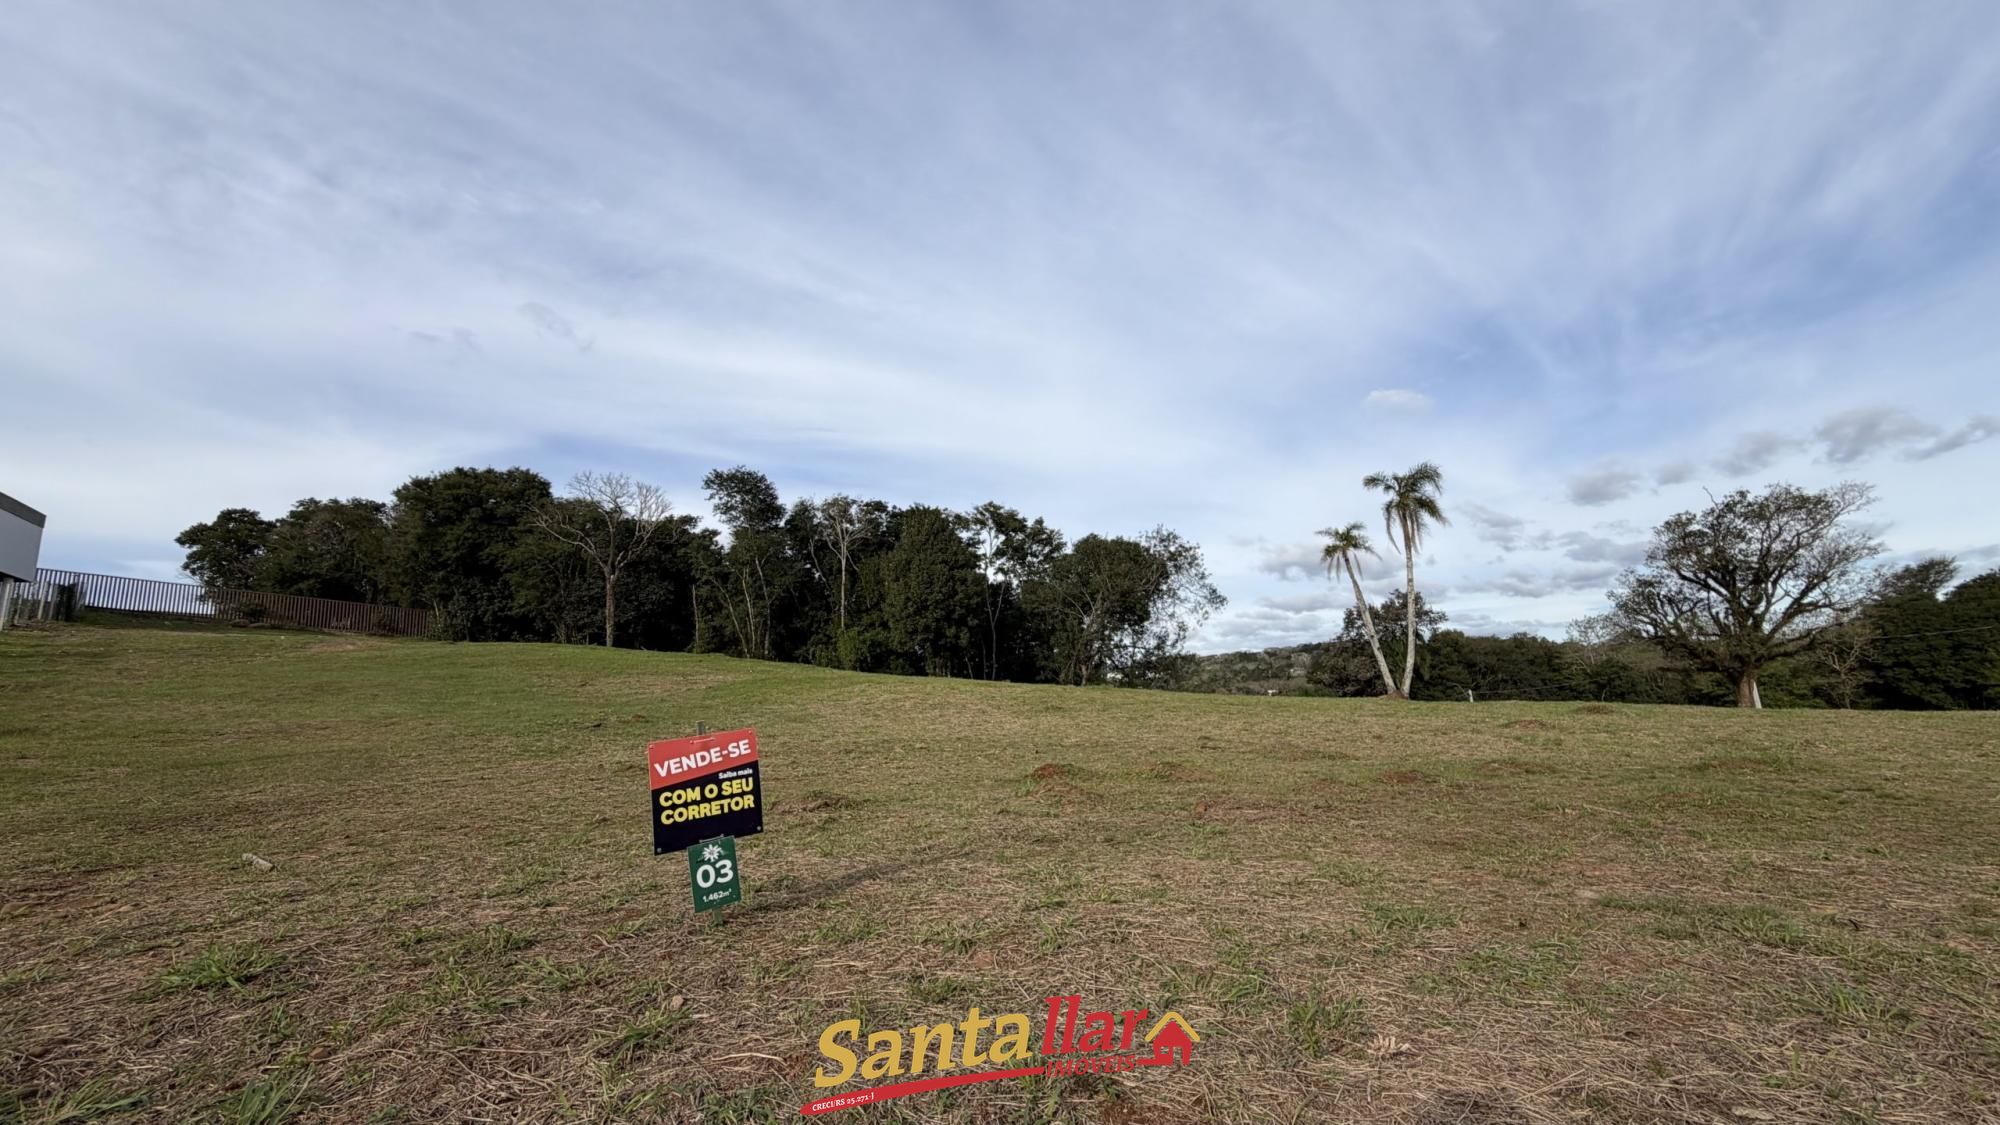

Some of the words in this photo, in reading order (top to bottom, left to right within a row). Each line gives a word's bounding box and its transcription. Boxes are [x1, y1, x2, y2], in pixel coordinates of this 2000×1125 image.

[654, 739, 751, 777] VENDE-SE
[718, 771, 737, 779] Saiba
[737, 768, 753, 776] mais
[659, 786, 701, 807] COM
[704, 783, 718, 799] O
[721, 777, 754, 796] SEU
[660, 794, 755, 825] CORRETOR
[696, 859, 734, 888] 03
